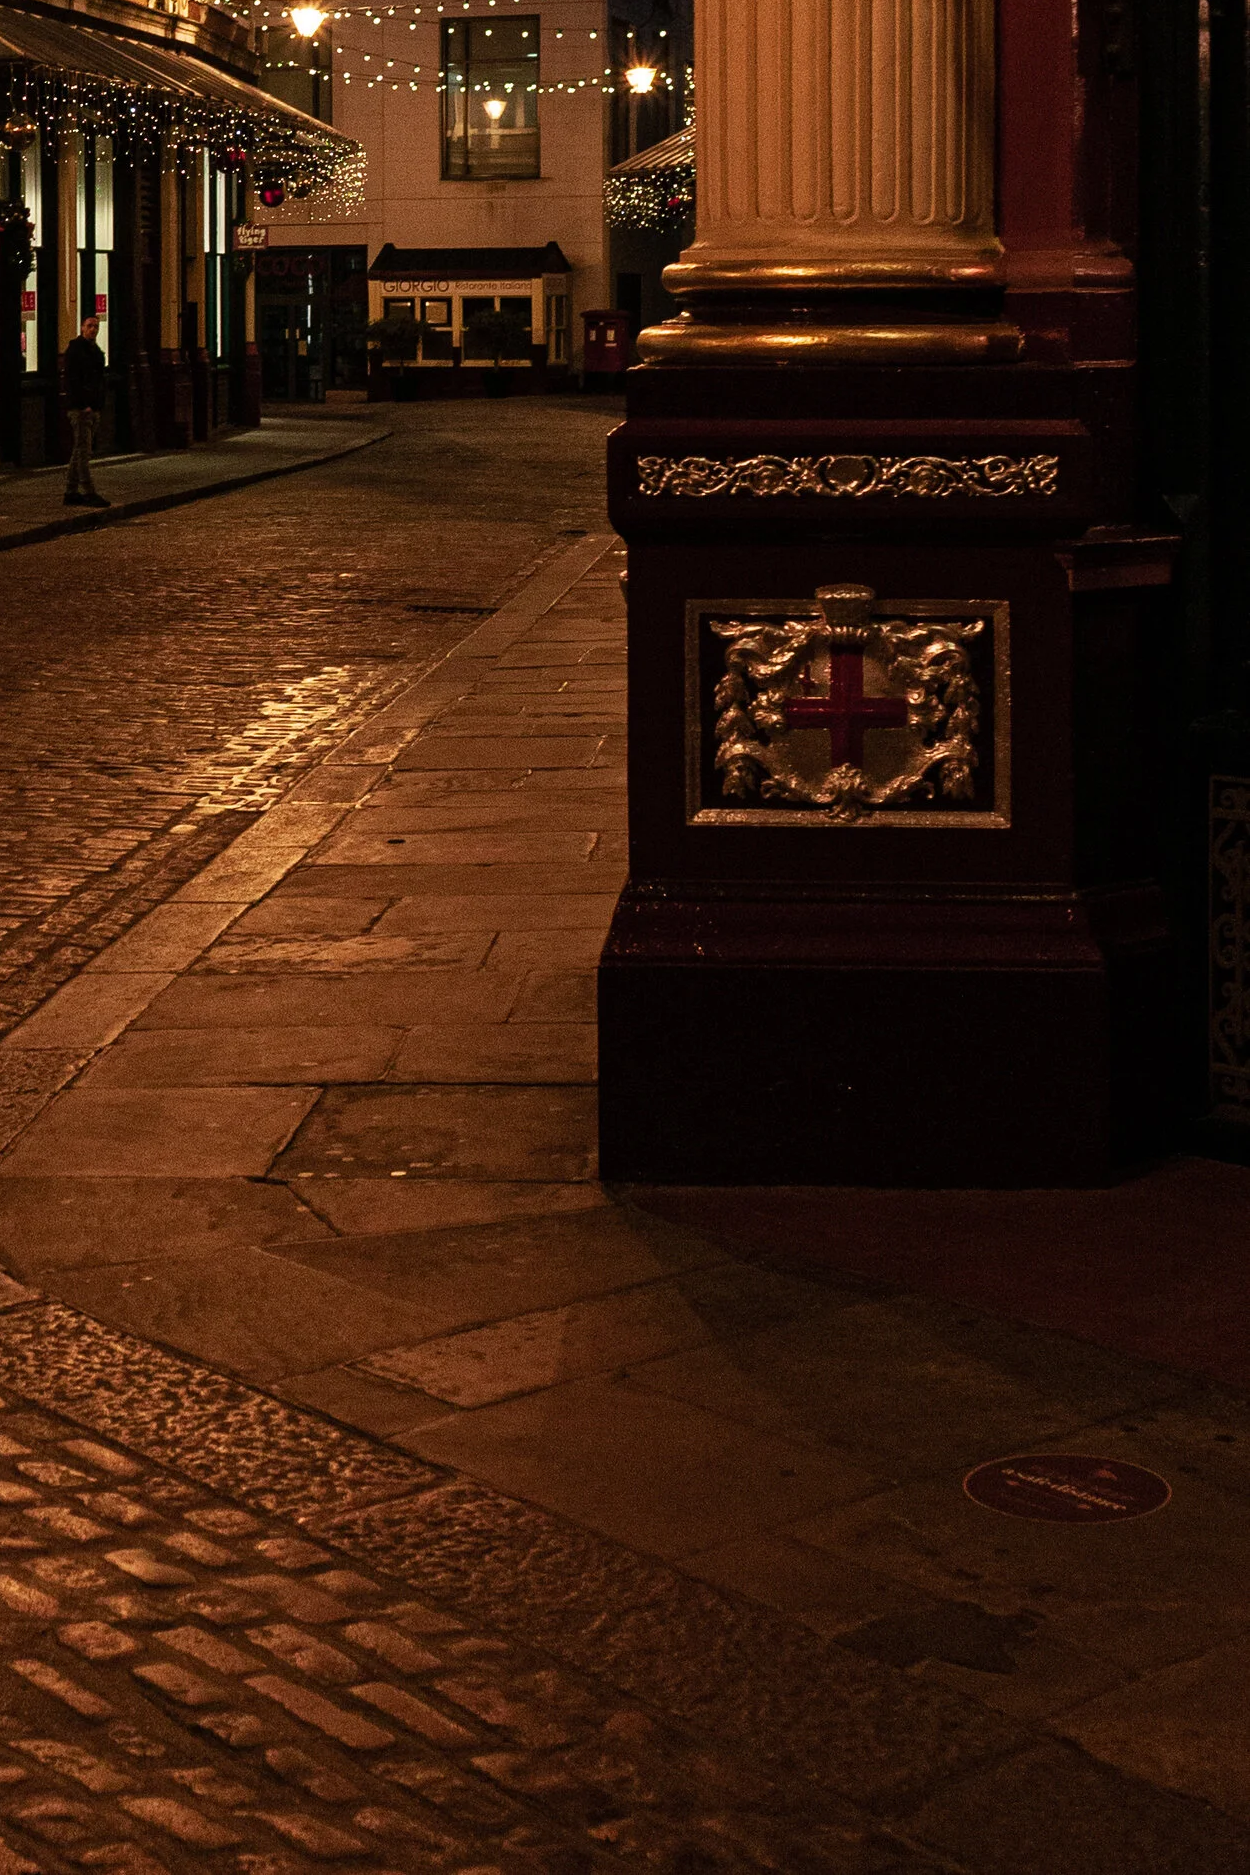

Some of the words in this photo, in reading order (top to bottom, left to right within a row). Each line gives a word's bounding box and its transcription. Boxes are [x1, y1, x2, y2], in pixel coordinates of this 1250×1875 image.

[236, 224, 266, 237] flying
[238, 235, 265, 245] tiger
[383, 279, 450, 293] GIORGIO
